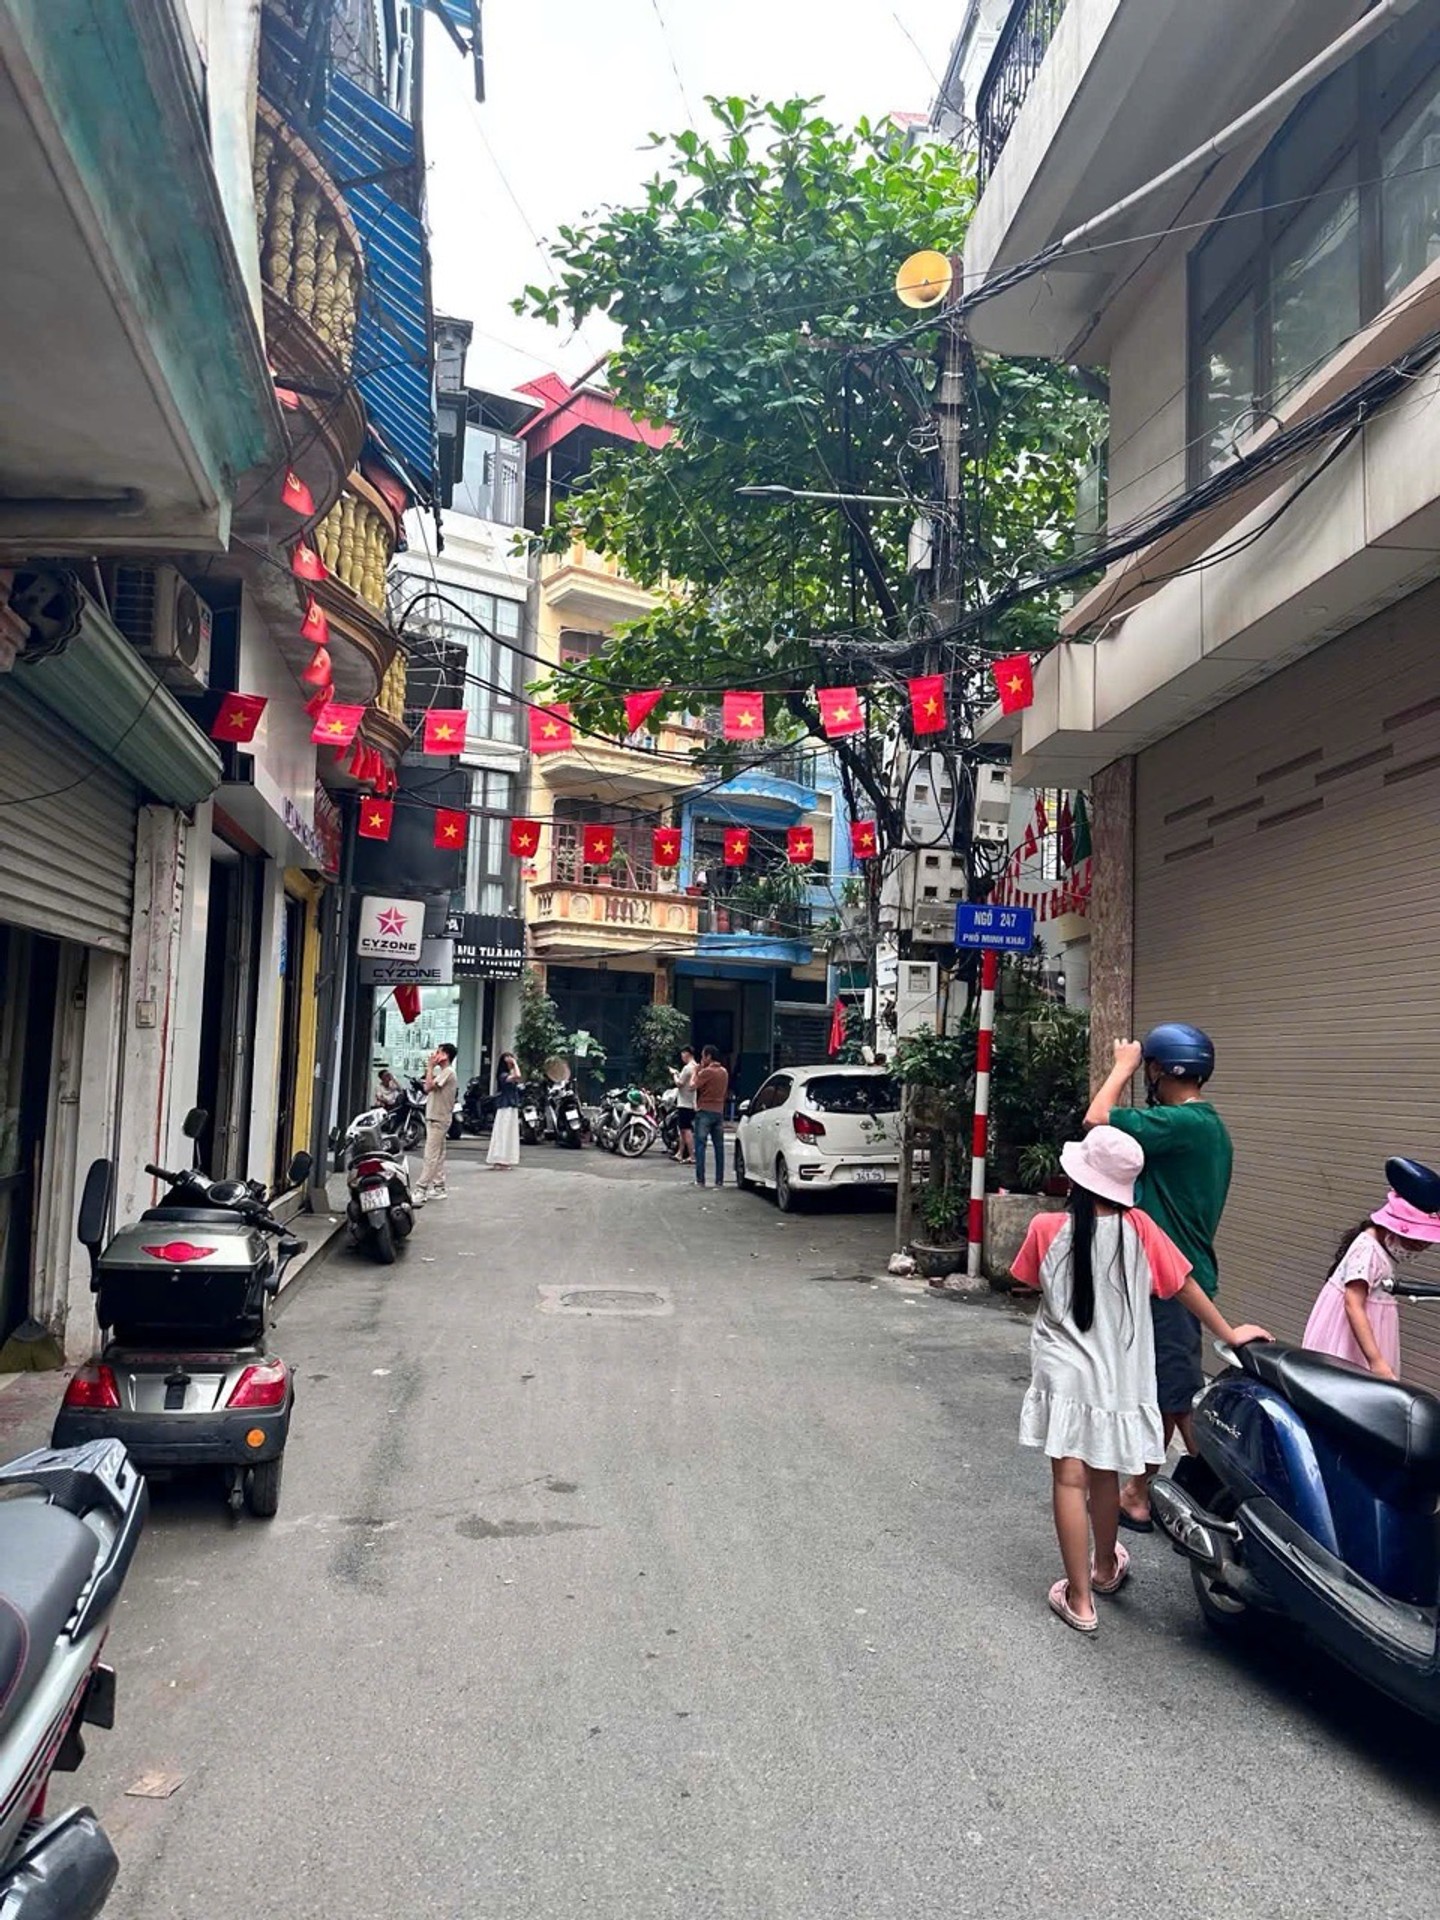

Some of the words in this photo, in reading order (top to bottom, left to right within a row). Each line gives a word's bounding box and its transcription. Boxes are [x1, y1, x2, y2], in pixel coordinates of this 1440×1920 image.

[1000, 913, 1017, 927] 247
[362, 938, 417, 951] CYZONE
[981, 934, 1004, 945] MINH
[1005, 936, 1026, 945] KHAI
[373, 968, 441, 978] CYZONE
